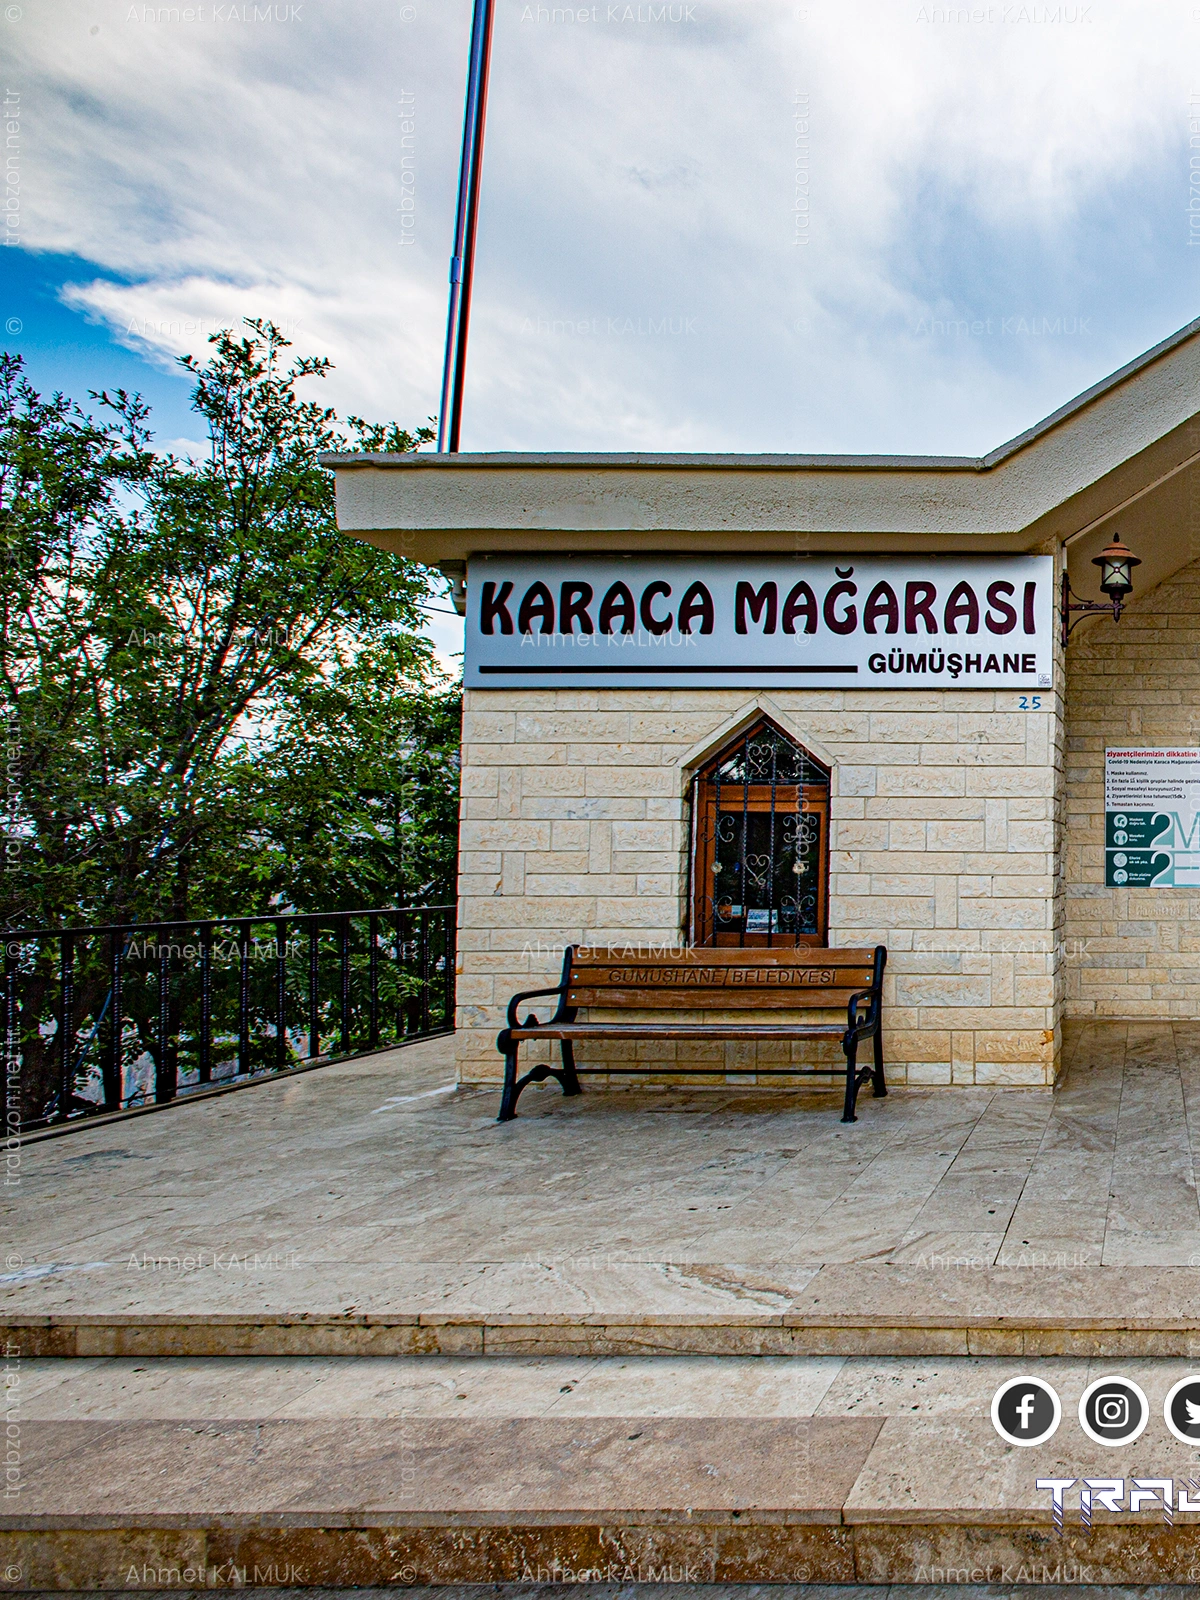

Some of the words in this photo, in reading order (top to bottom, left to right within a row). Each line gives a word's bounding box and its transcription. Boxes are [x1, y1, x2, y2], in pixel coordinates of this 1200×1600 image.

[480, 580, 716, 636] KARACA
[734, 566, 1038, 635] MAĞARASI
[868, 648, 1037, 679] GÜMÜŞHANE
[1018, 695, 1042, 711] 25
